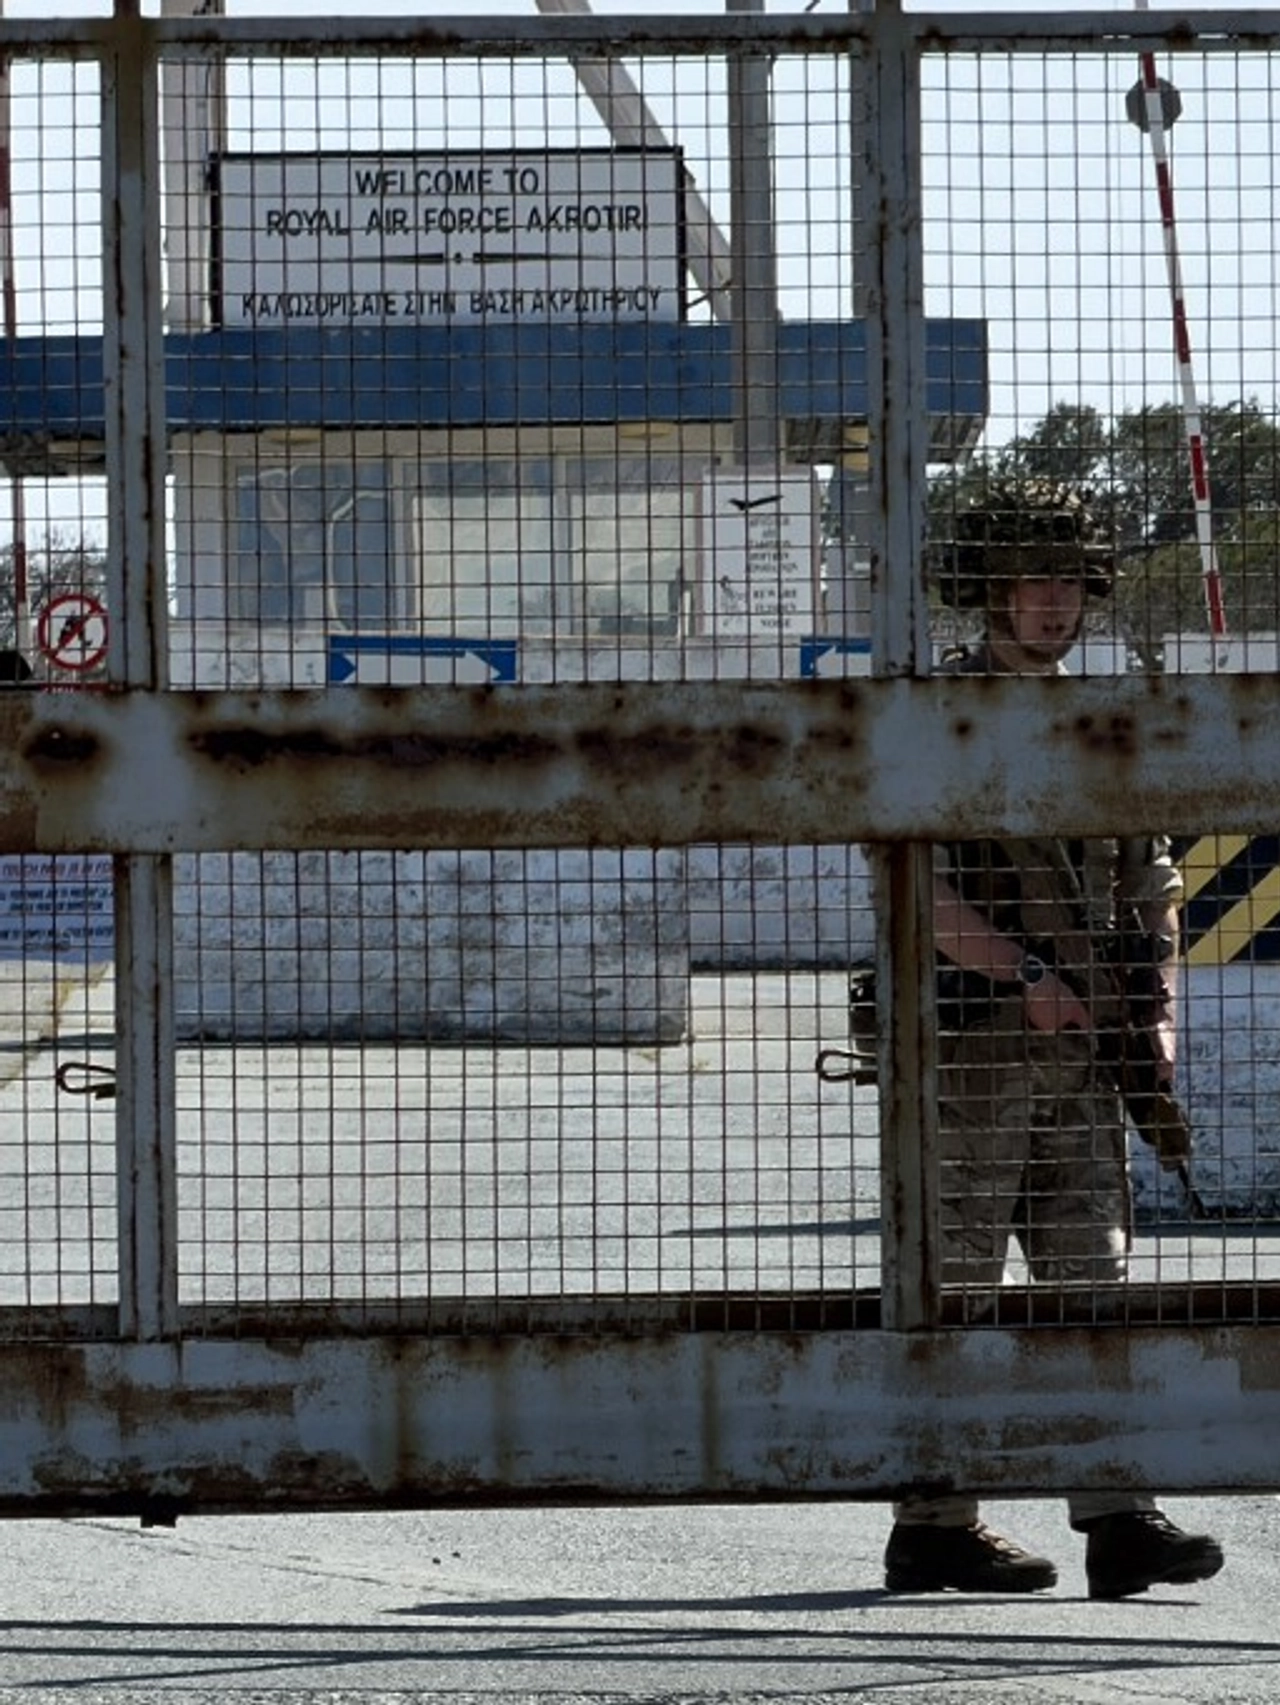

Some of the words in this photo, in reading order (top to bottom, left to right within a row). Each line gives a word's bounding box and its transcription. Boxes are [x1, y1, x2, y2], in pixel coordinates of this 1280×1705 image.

[355, 169, 492, 195] WELCOME
[503, 168, 539, 194] TO
[266, 209, 350, 236] ROYAL
[366, 208, 410, 235] AIR
[424, 207, 510, 234] FORCE
